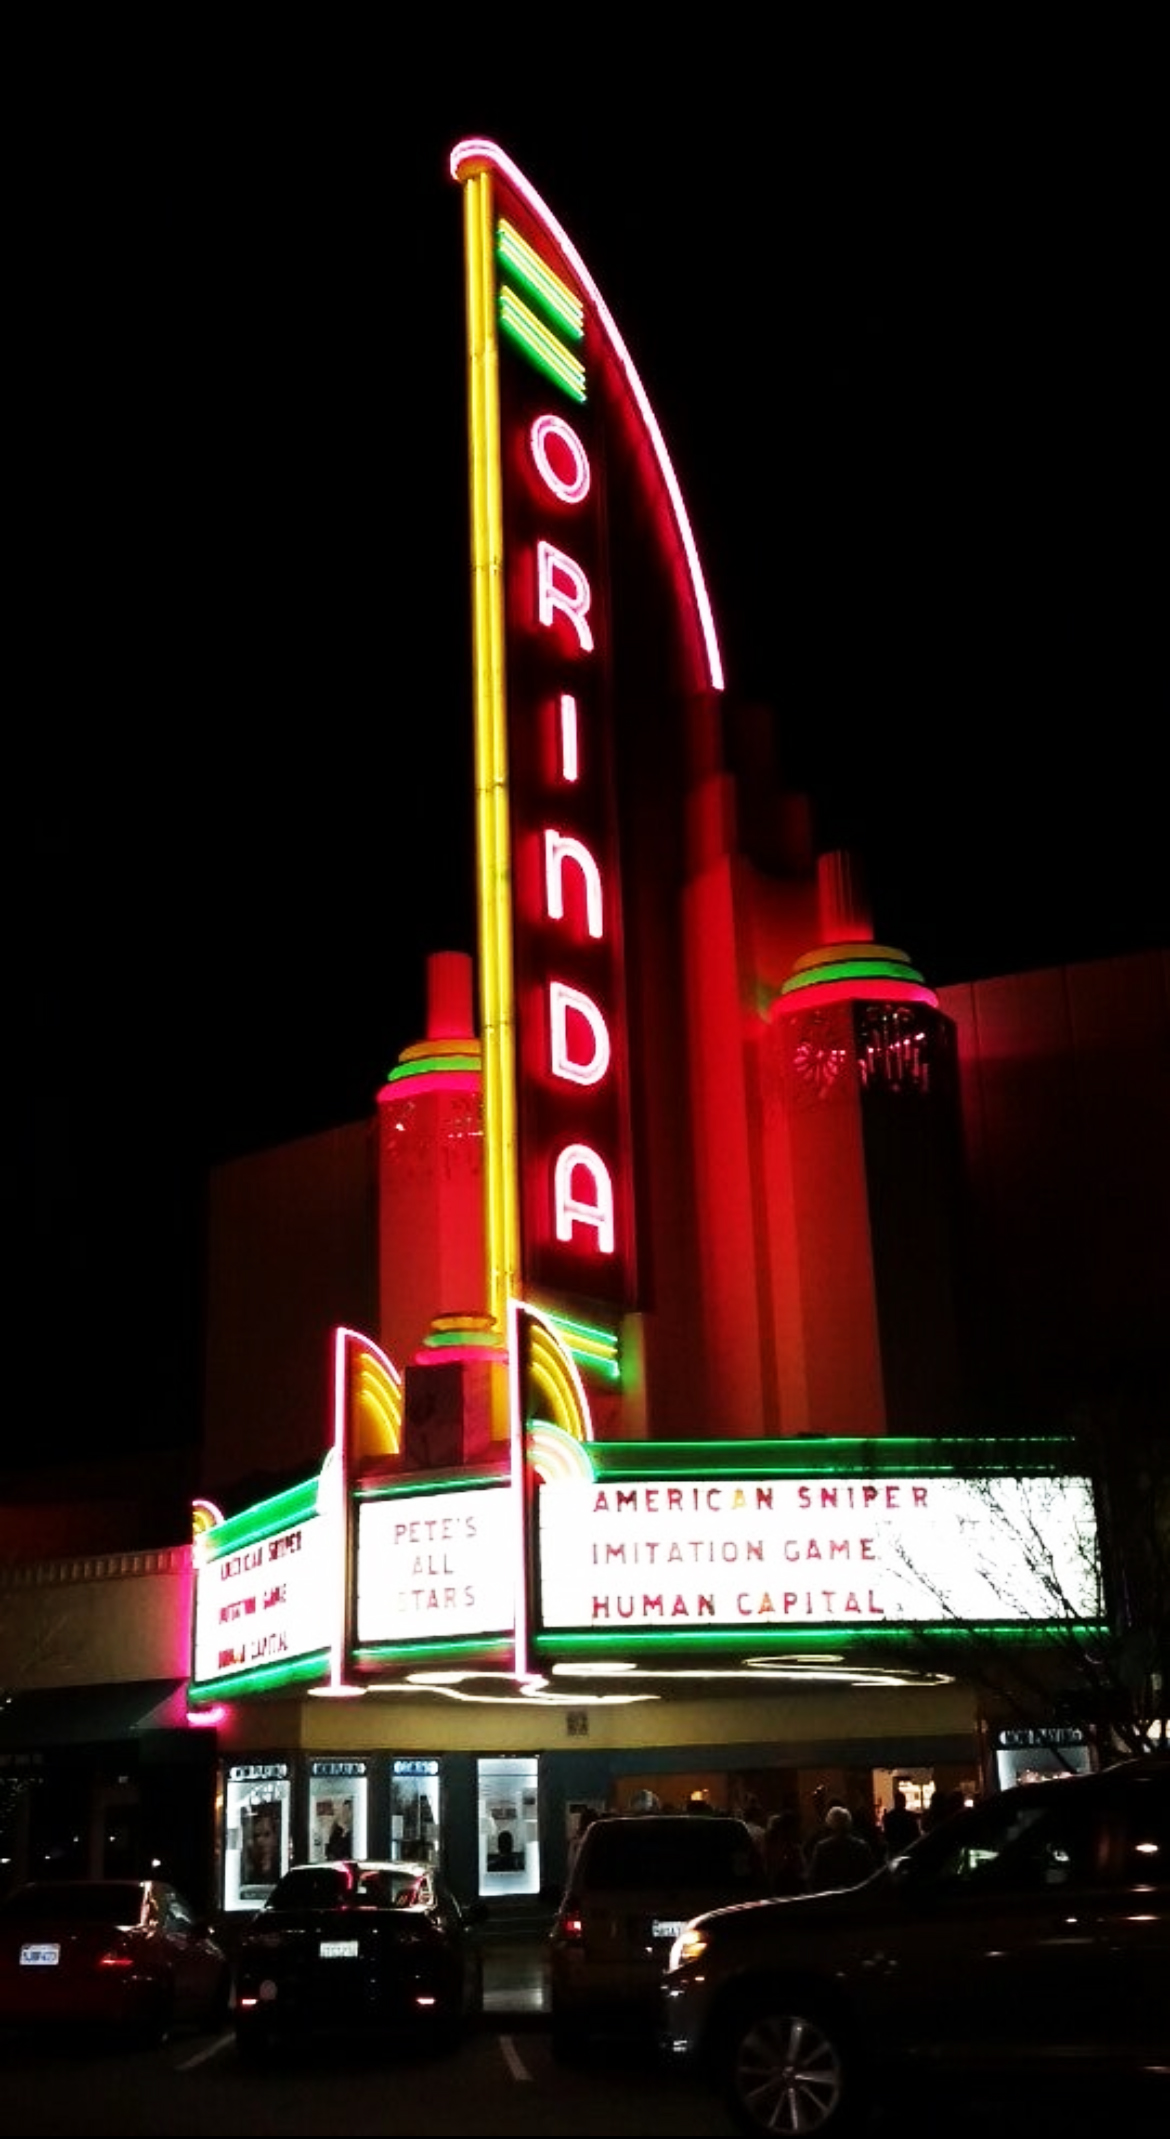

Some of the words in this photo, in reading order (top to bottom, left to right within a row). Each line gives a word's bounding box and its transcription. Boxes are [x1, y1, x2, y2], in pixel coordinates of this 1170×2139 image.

[529, 413, 615, 1254] ORINDA
[592, 1486, 775, 1513] AMERICAN
[796, 1482, 929, 1510] SNIPER
[394, 1515, 477, 1545] PETE'S
[412, 1552, 454, 1576] ALL
[592, 1538, 765, 1565] IMITATION
[783, 1537, 876, 1562] GAME
[591, 1593, 716, 1619] HUMAN
[736, 1589, 885, 1617] CAPITAL
